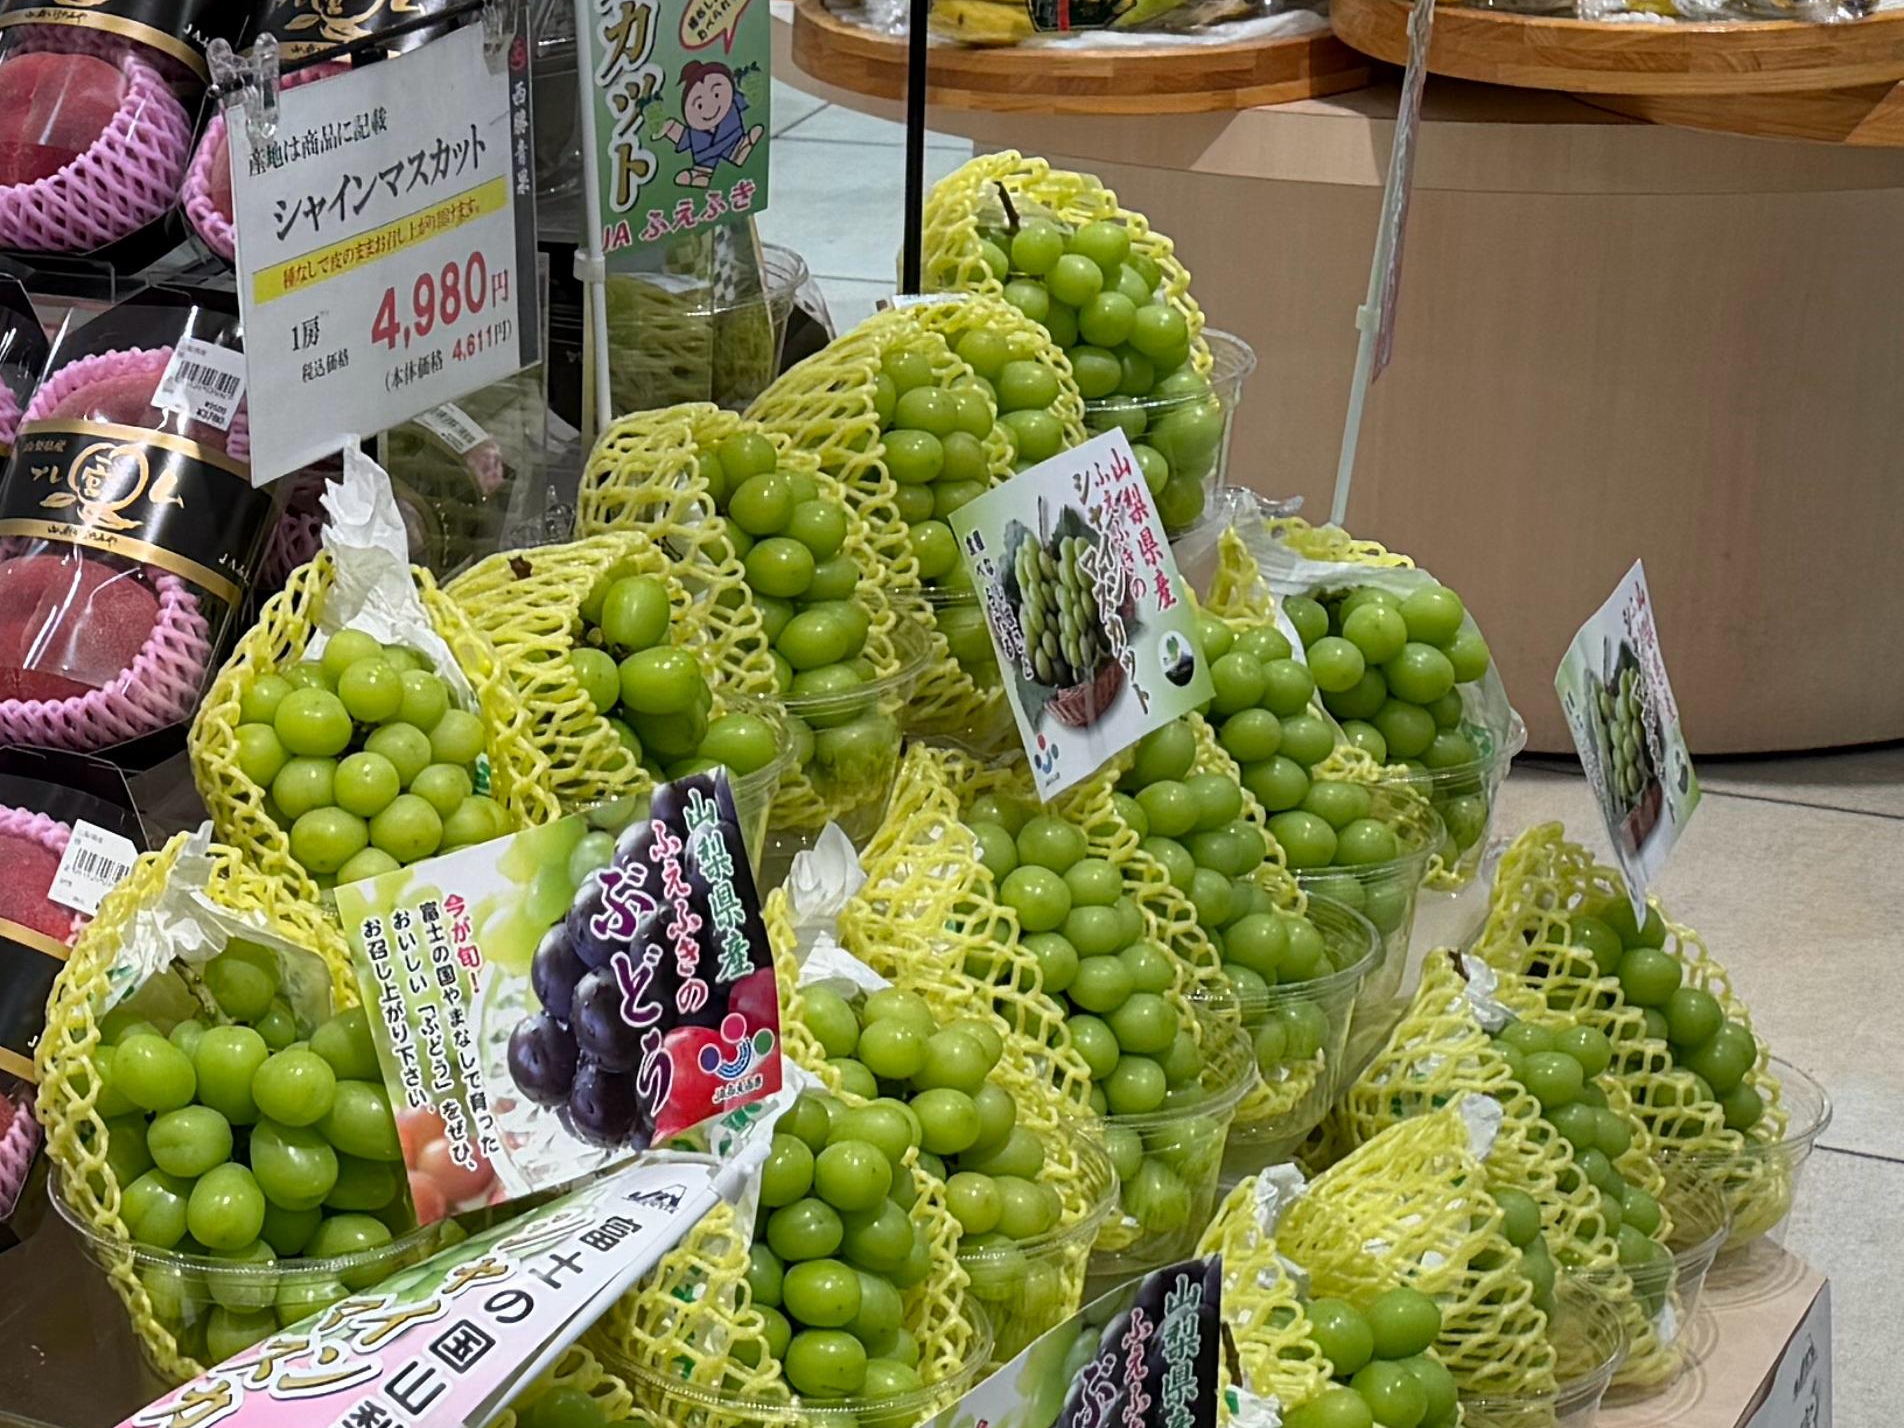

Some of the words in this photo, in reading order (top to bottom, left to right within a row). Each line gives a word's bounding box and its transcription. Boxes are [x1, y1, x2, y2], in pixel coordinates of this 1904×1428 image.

[249, 107, 388, 176] 産地は商品に記載
[273, 123, 486, 240] シャインマスカット
[641, 180, 758, 241] ふえふき
[302, 348, 349, 382] 税込価格
[371, 250, 509, 350] 4,980円
[452, 319, 512, 361] 4,611円)
[1111, 448, 1177, 611] 山梨県産
[442, 892, 483, 996] 今が旬！
[648, 819, 709, 1015] ふえふきの
[684, 788, 755, 984] 山梨県産
[362, 918, 436, 1114] お召し上がり下さい。
[419, 901, 501, 1154] 富士の国やまなしで育った
[590, 862, 674, 1117] ぶどう
